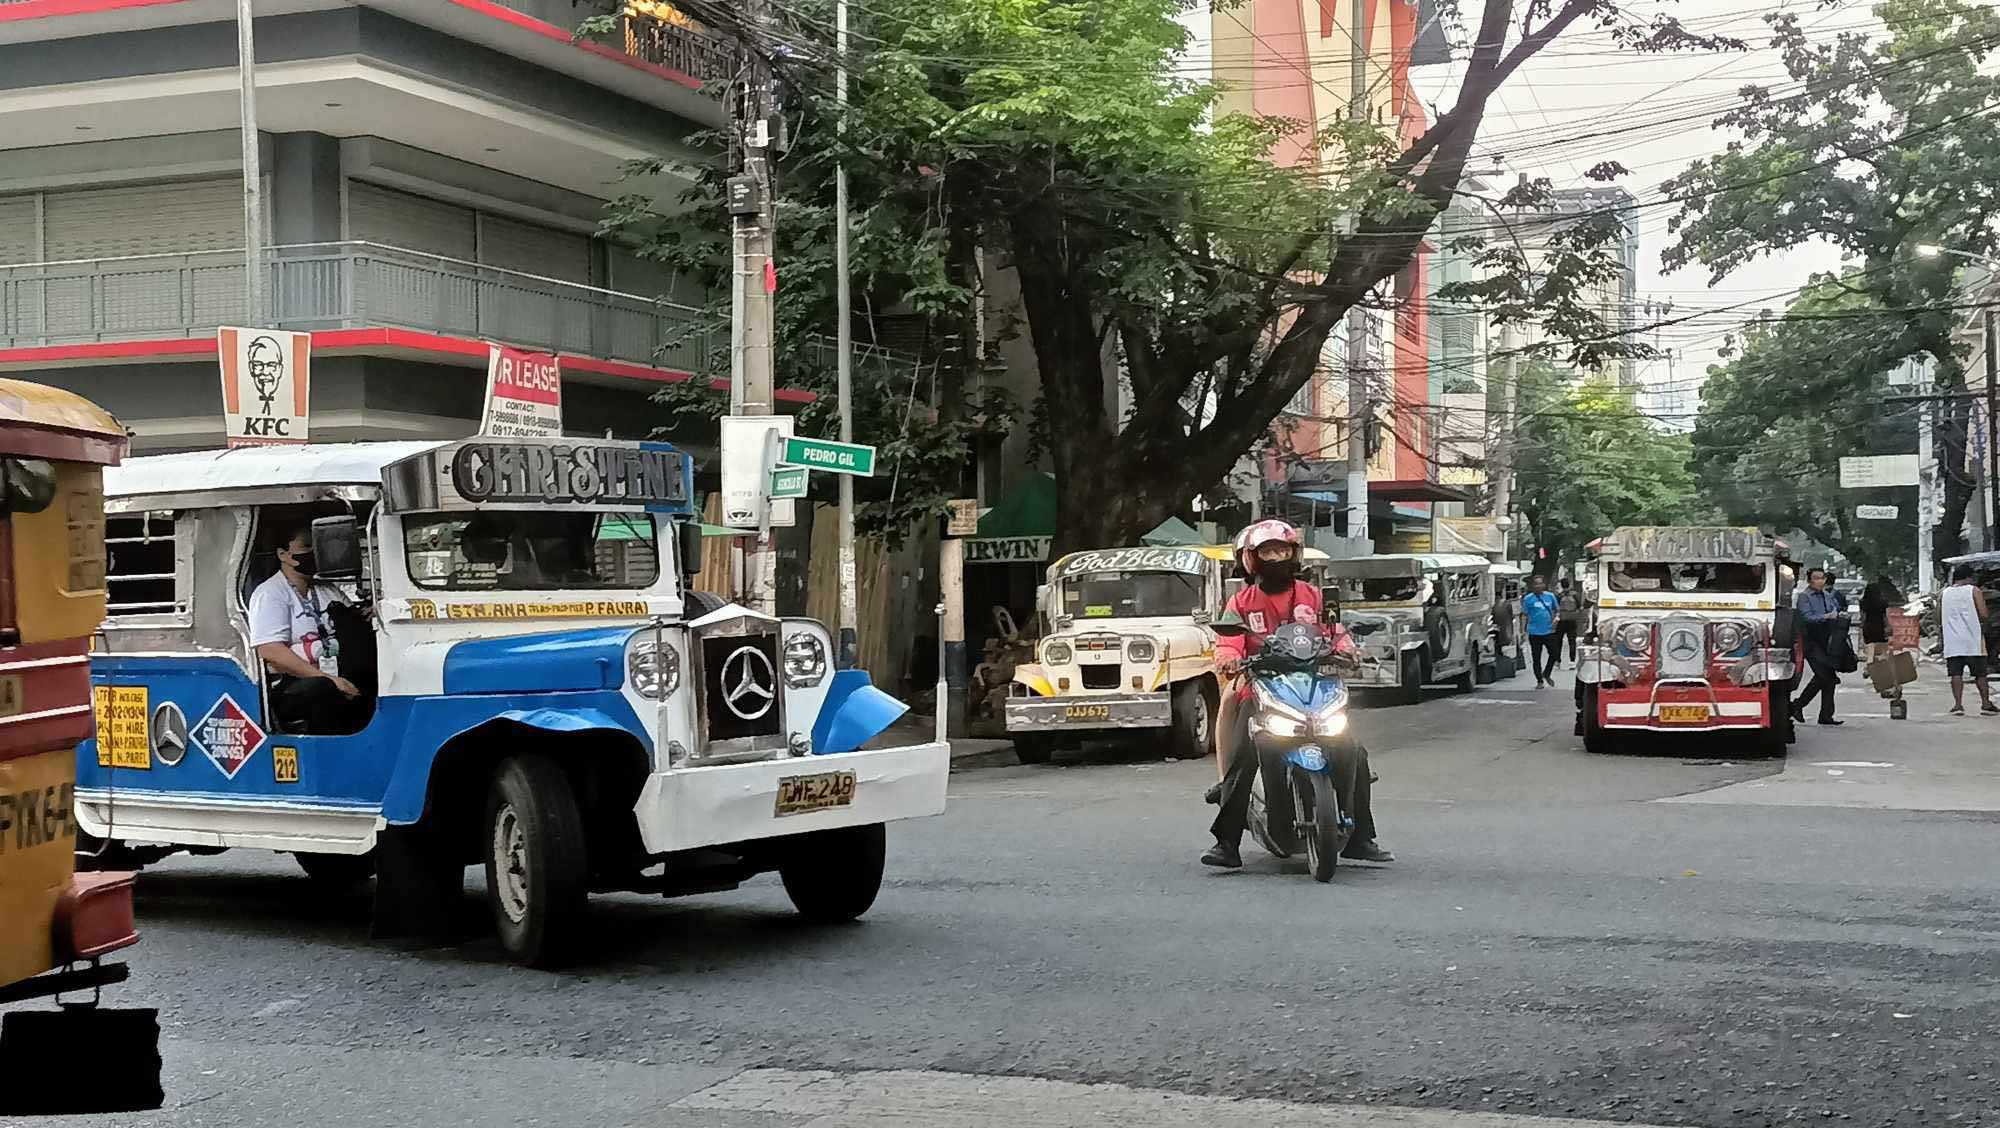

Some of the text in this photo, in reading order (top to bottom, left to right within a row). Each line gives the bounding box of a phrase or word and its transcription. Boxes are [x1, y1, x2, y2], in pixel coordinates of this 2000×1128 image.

[516, 360, 558, 393] LEASE
[243, 417, 289, 436] KFC
[803, 447, 856, 466] PEDRO GIL
[965, 540, 1039, 560] IRWIN
[1064, 551, 1122, 574] God
[413, 605, 436, 618] 212
[126, 721, 144, 735] HIRE
[276, 759, 297, 779] 212
